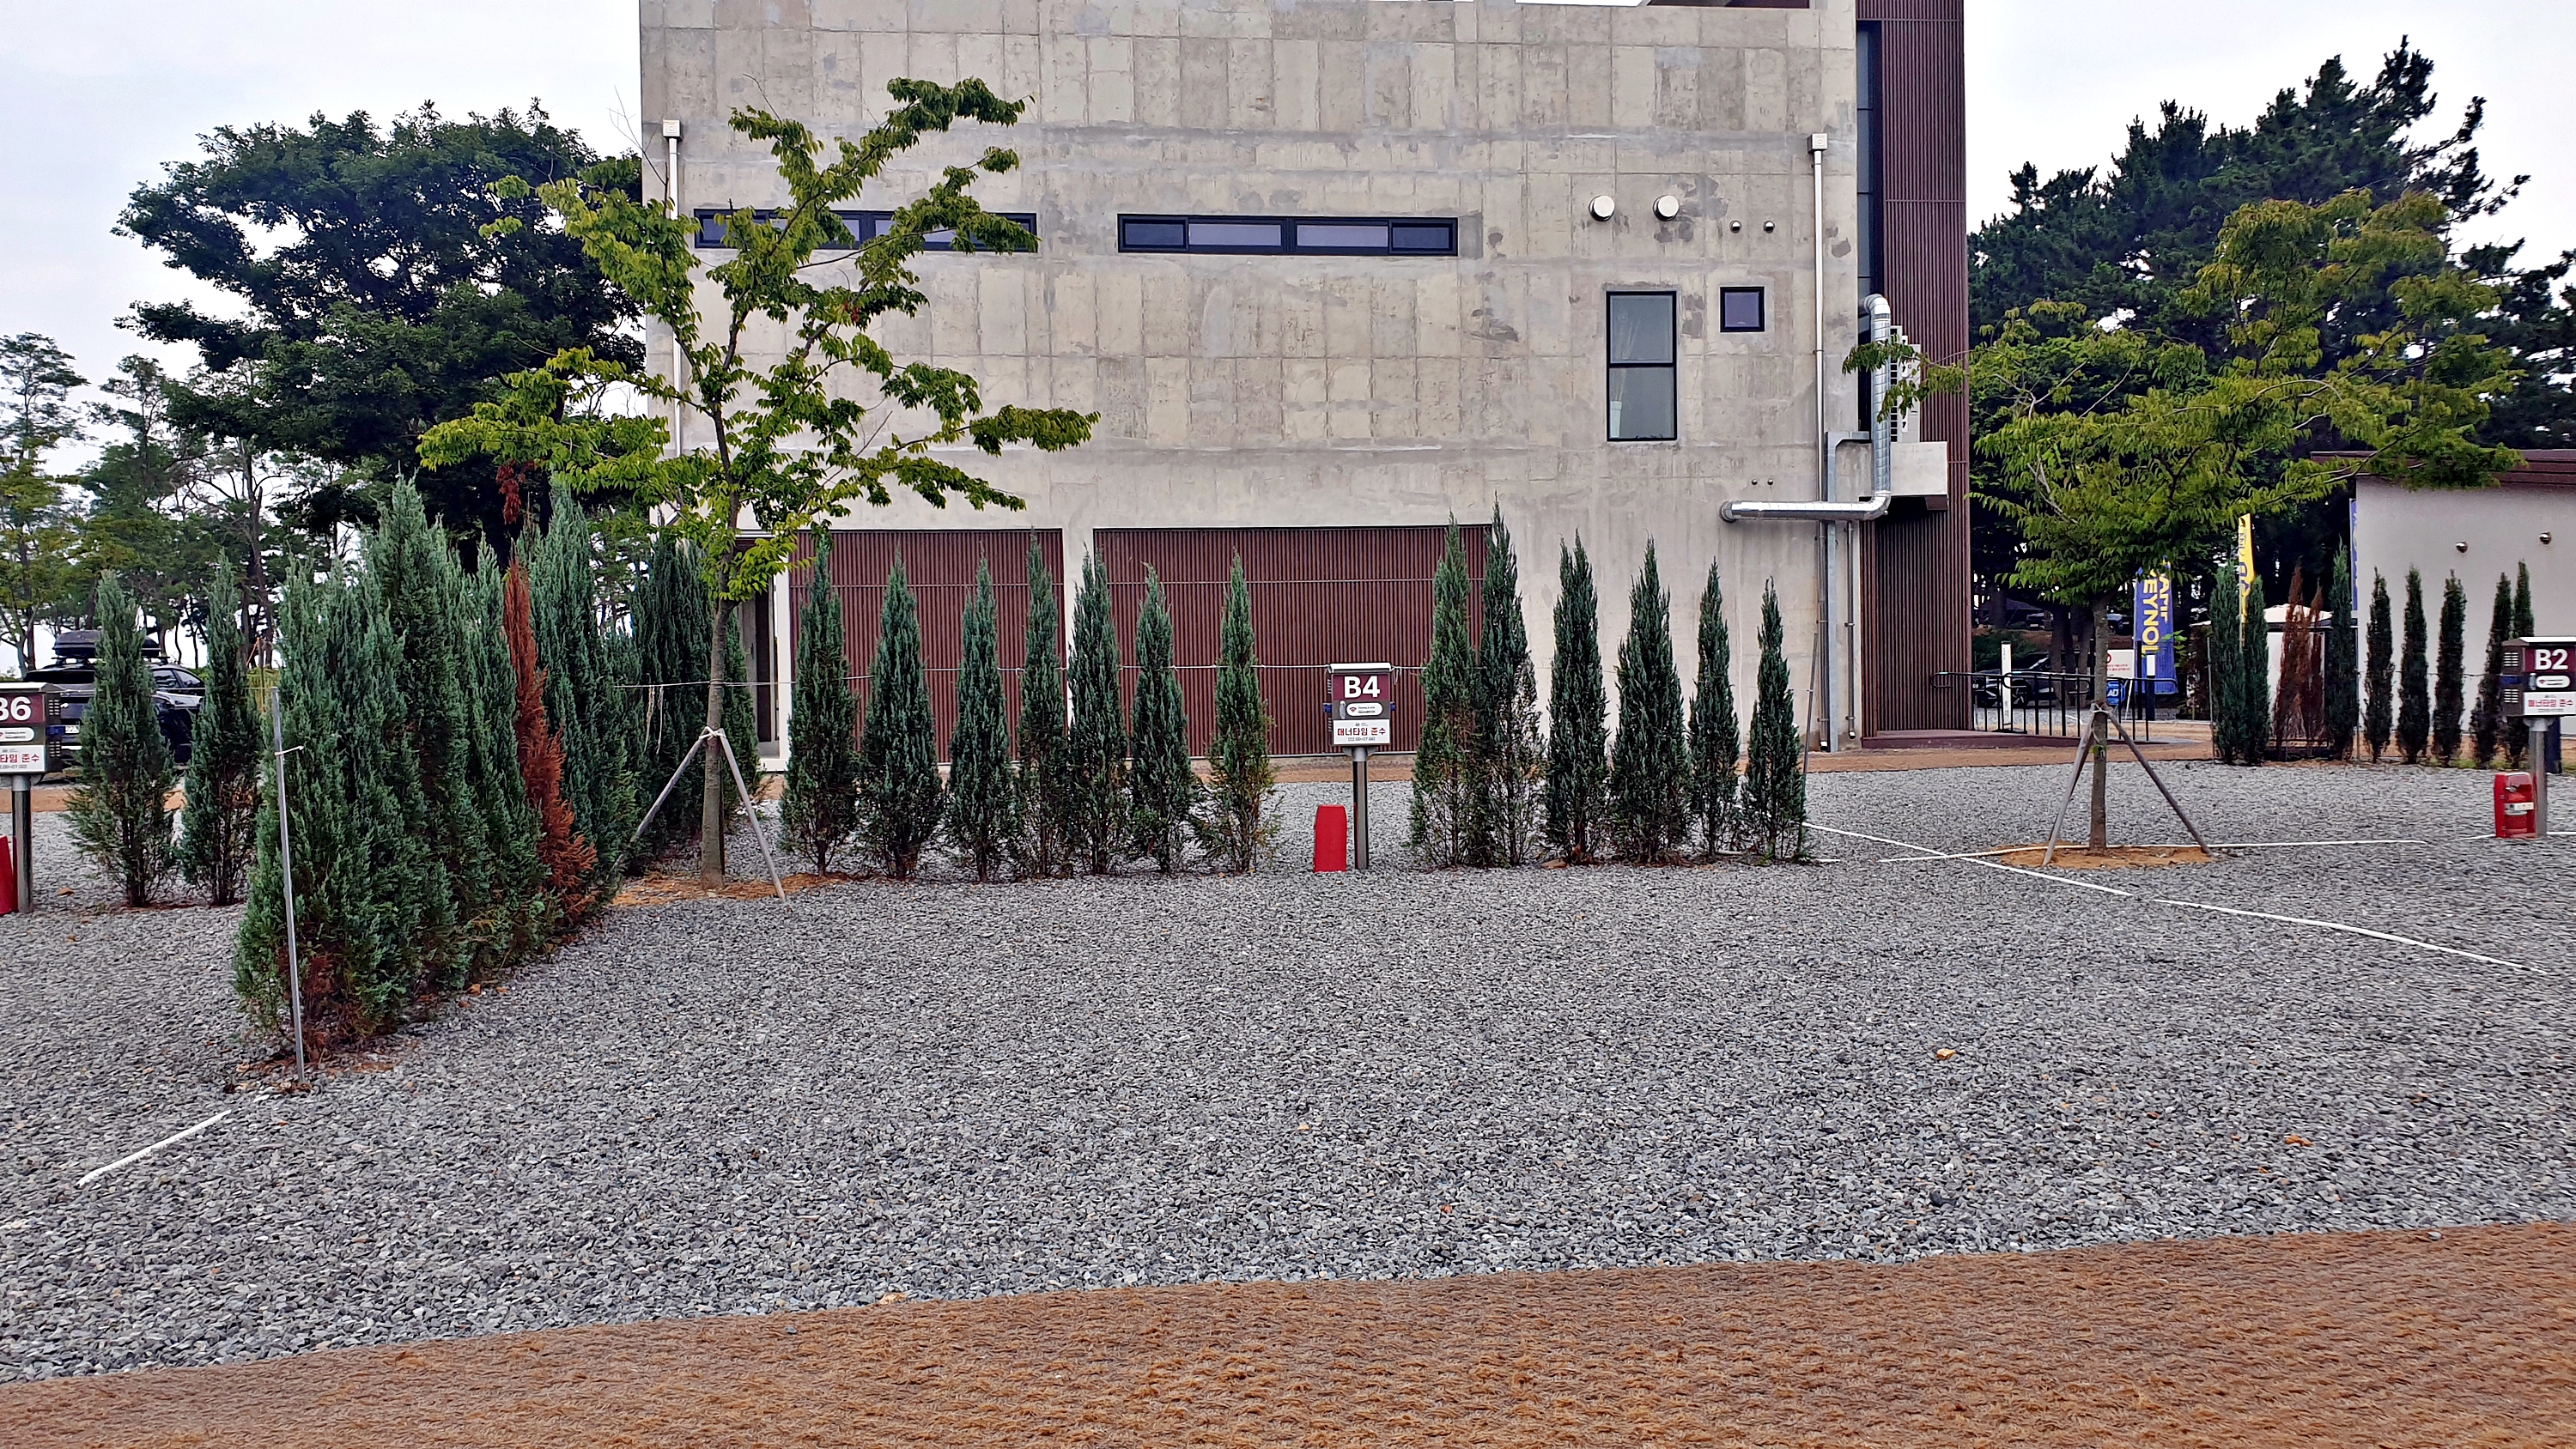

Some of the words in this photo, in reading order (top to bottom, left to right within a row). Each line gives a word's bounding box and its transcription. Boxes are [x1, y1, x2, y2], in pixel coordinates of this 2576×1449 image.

[2535, 648, 2568, 670] B2
[1344, 676, 1381, 698] B4
[1337, 727, 1368, 736] 매너타임
[1370, 727, 1386, 736] 준수
[21, 754, 39, 763] 준수
